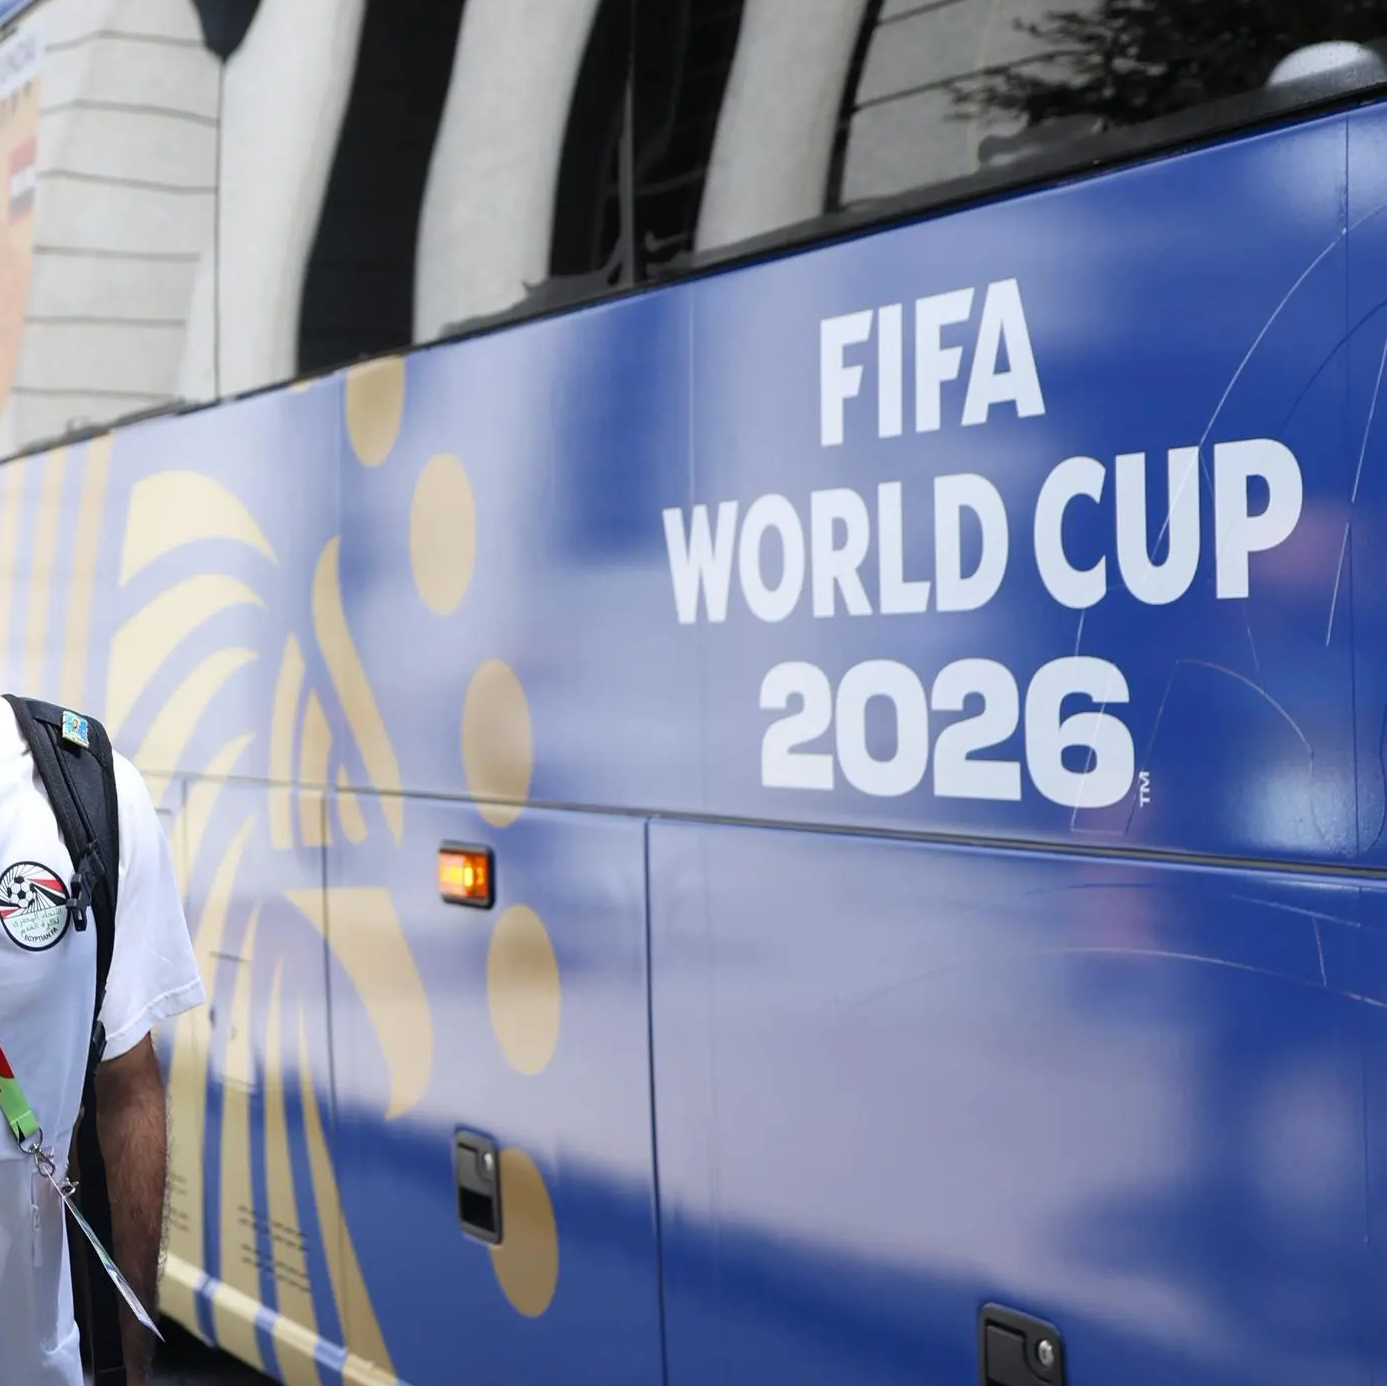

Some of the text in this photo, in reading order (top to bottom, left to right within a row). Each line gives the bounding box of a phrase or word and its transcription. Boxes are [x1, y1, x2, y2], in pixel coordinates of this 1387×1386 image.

[820, 277, 1047, 447] FIFA
[662, 437, 1303, 625] WORLD CUP
[759, 655, 1135, 808] 2026
[24, 931, 51, 942] EGYPTIAN
